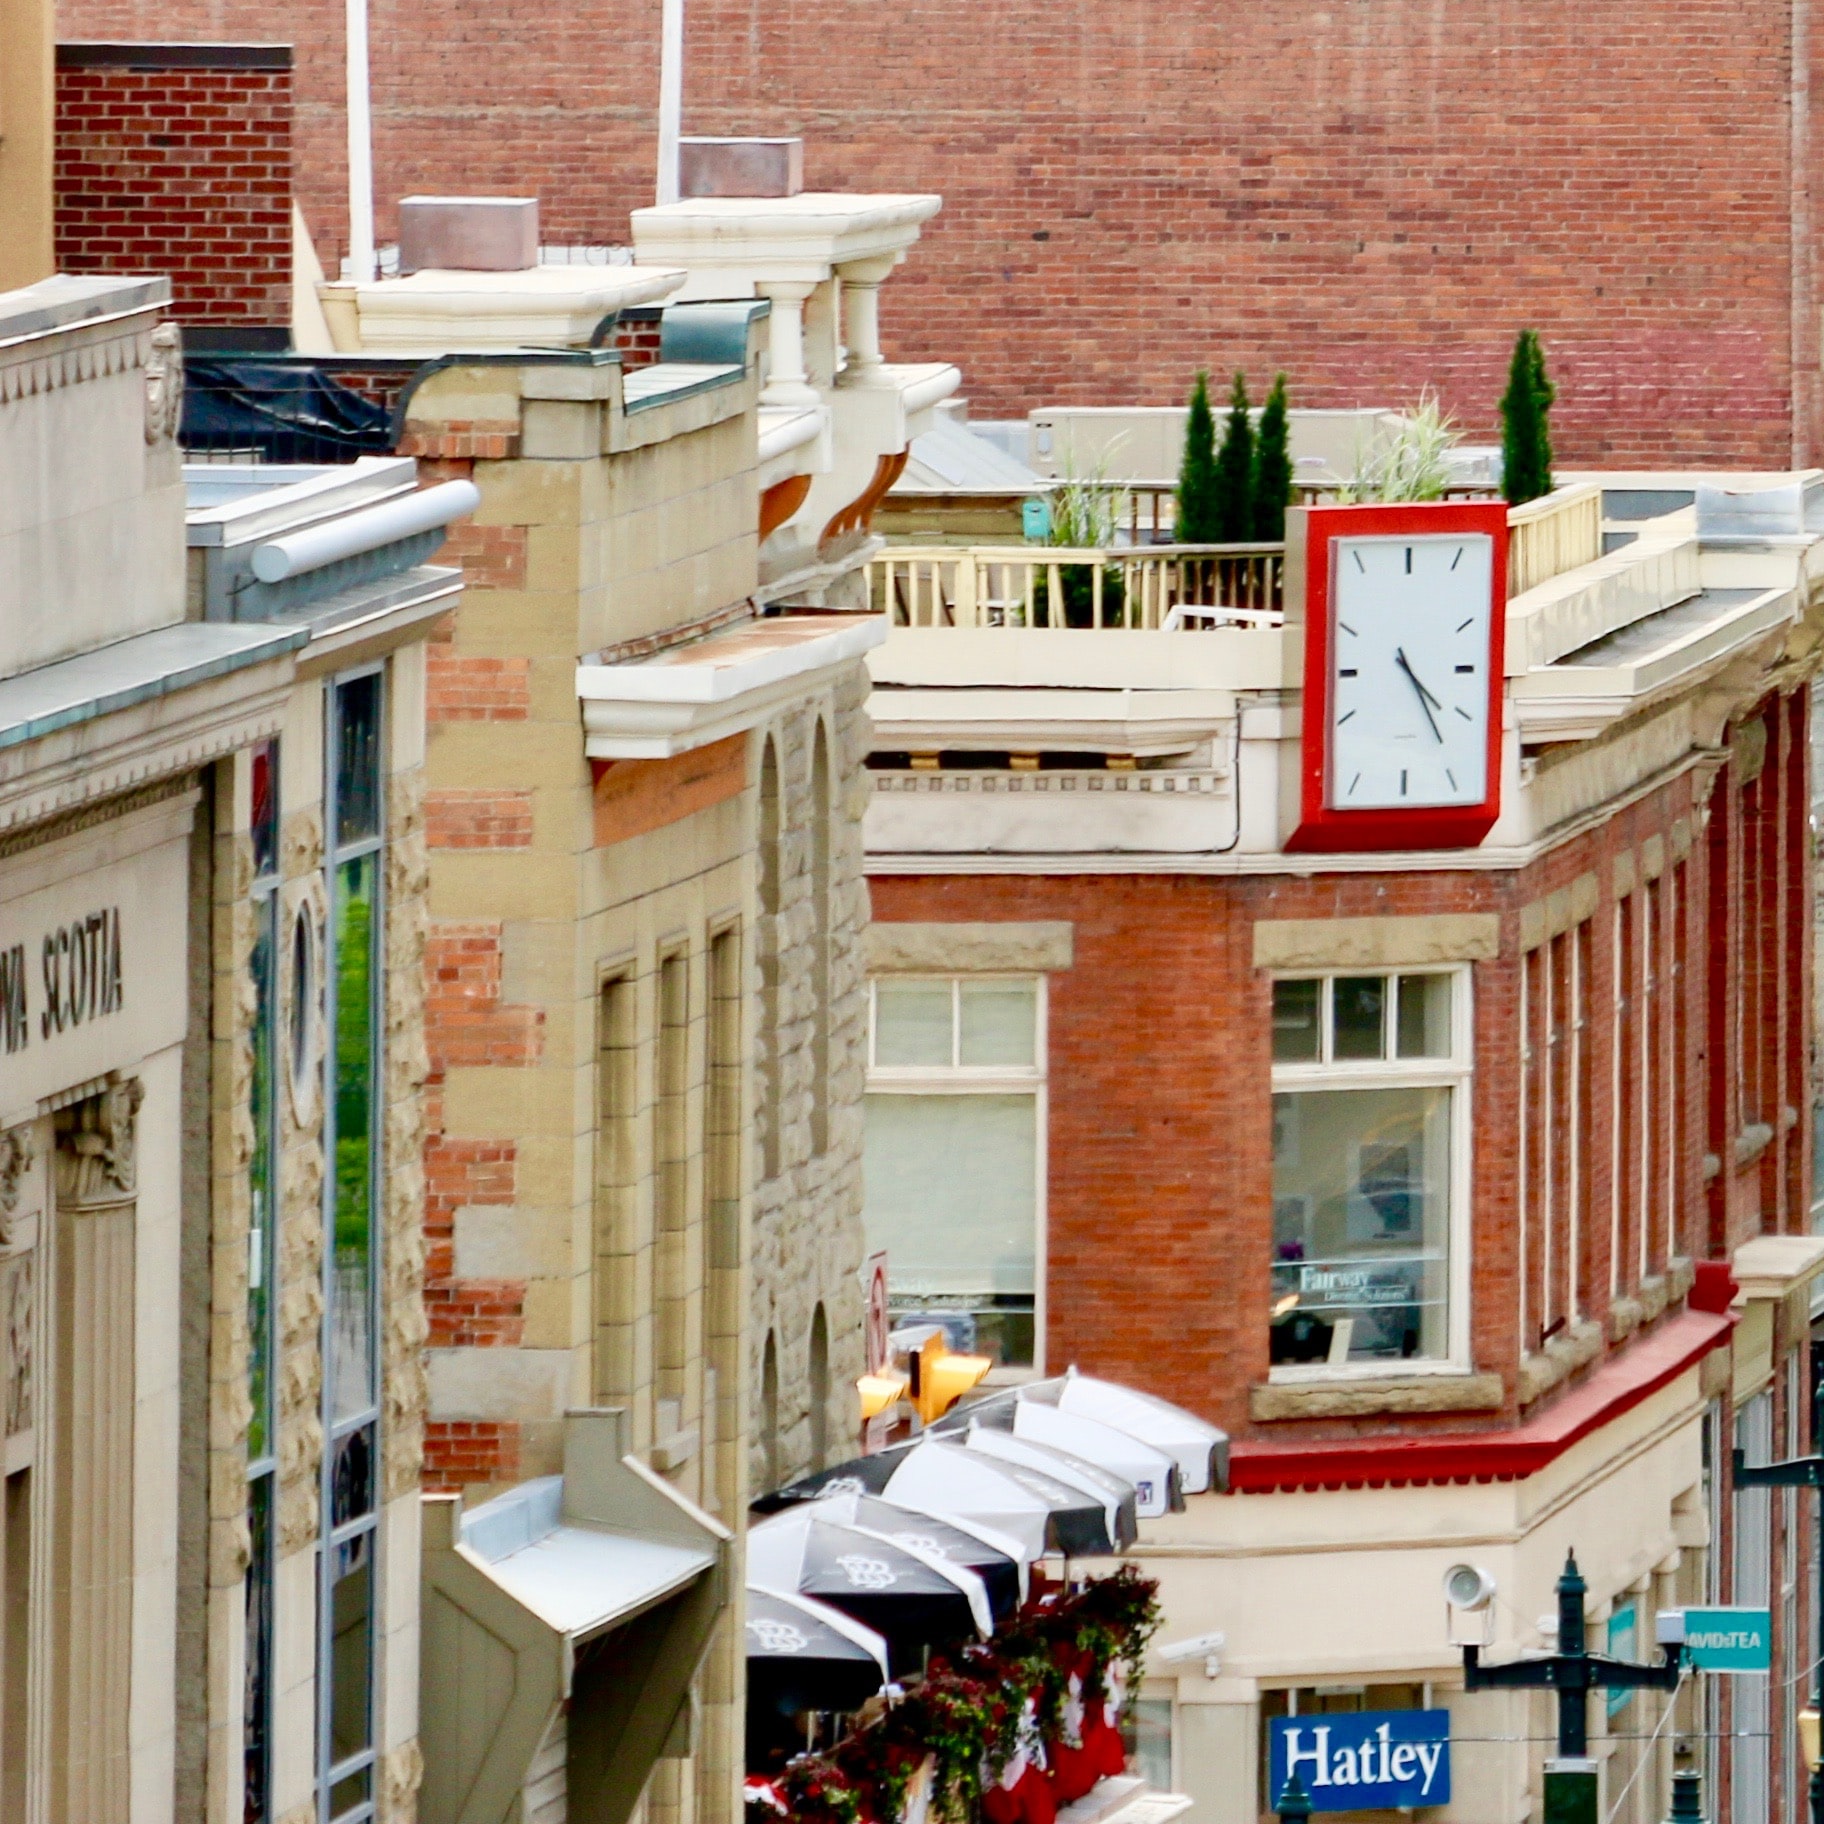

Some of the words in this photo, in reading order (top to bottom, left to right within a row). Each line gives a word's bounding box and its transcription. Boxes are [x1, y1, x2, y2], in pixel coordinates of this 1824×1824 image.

[0, 943, 28, 1055] VA
[41, 906, 122, 1041] SCOTIA
[1282, 1721, 1443, 1796] Hatley
